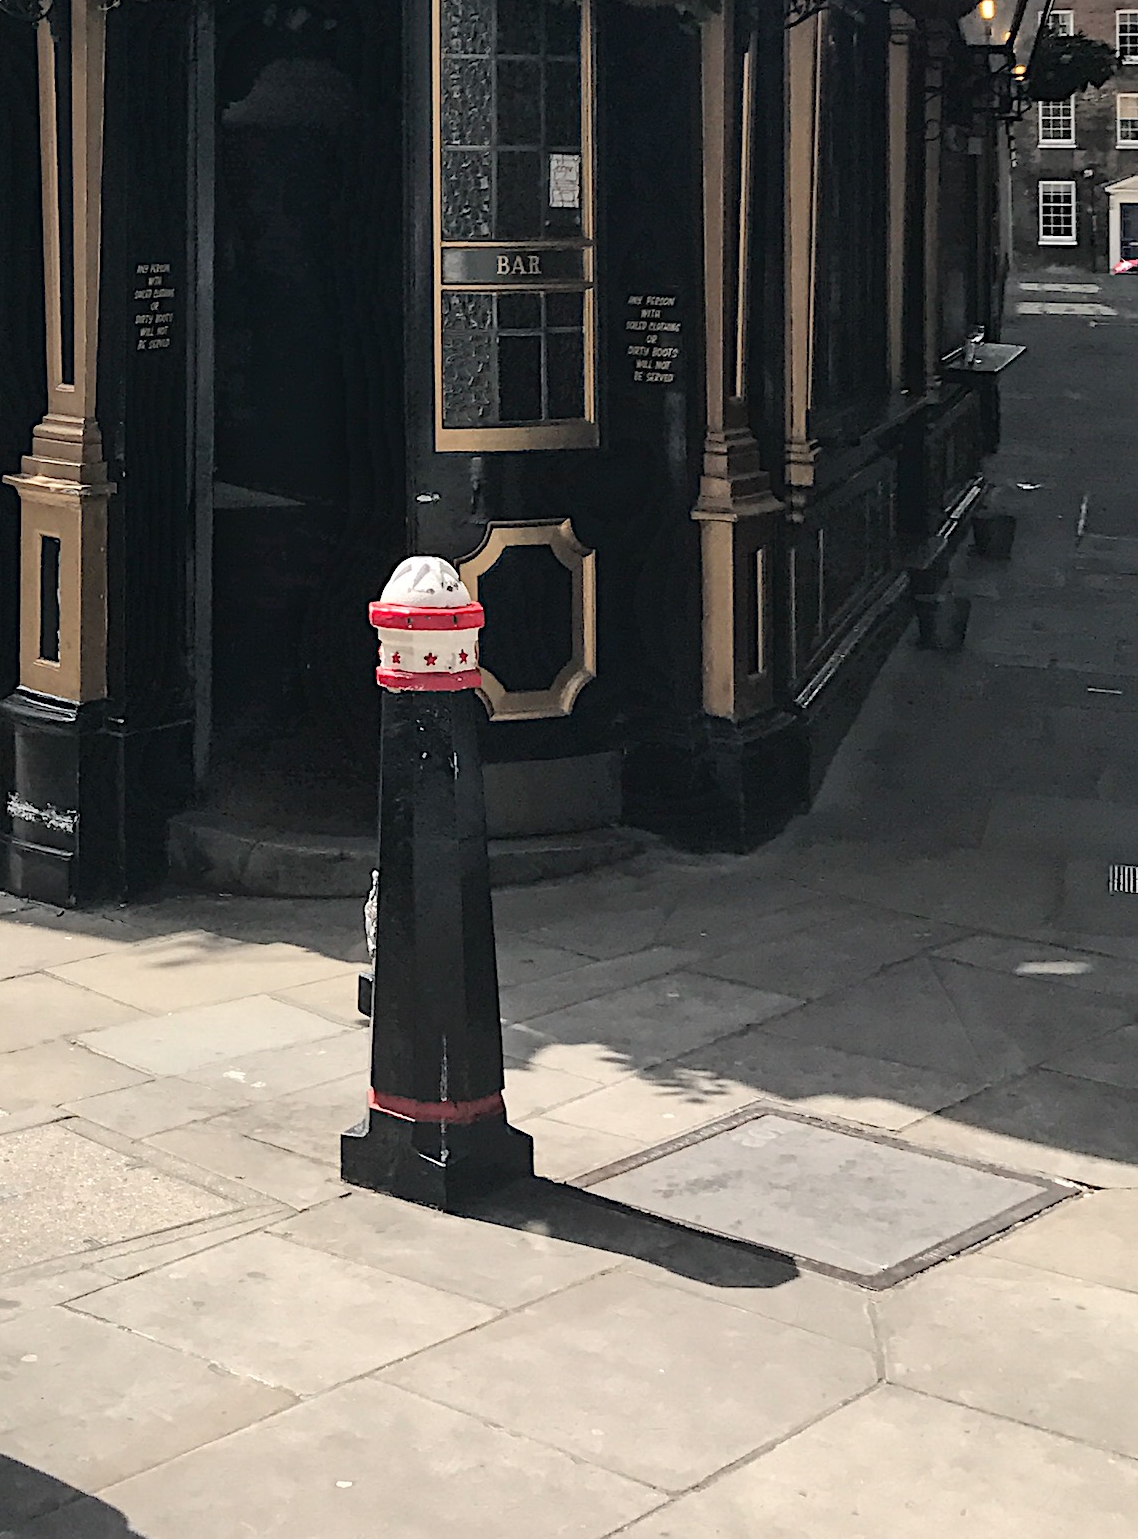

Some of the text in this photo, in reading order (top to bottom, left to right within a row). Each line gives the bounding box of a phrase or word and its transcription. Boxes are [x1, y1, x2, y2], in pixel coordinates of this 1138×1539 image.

[496, 255, 542, 275] BAR
[627, 345, 679, 359] DIRTY BOOTS
